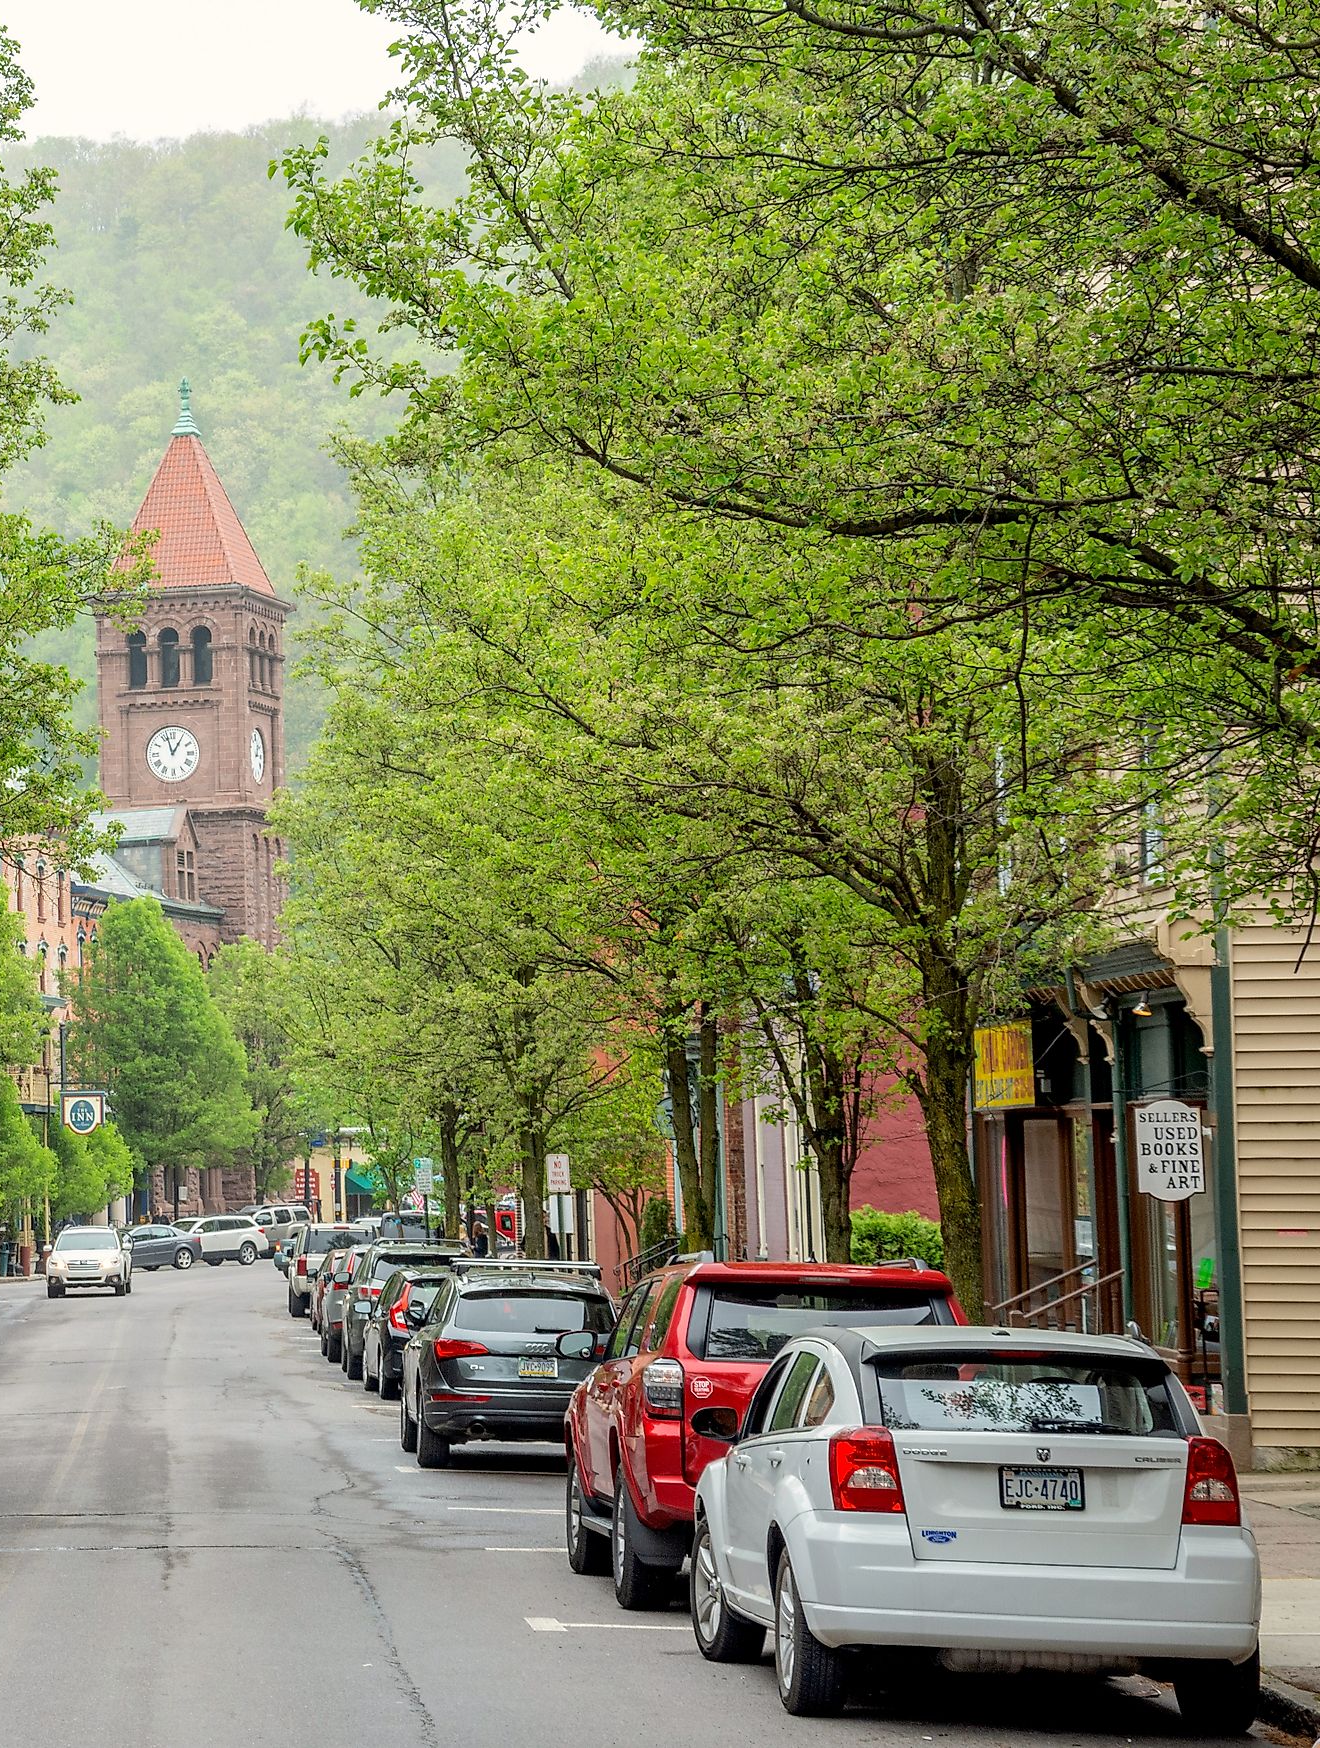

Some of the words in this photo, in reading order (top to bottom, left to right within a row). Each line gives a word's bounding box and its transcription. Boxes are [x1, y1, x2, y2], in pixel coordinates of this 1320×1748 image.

[72, 1112, 93, 1121] INN
[1139, 1112, 1198, 1122] SELLERS
[1154, 1127, 1198, 1140] USED
[1141, 1142, 1199, 1155] BOOKS
[553, 1160, 561, 1168] NO
[1148, 1163, 1158, 1173] &
[1161, 1160, 1200, 1173] FINE
[1166, 1176, 1200, 1188] ART
[902, 1447, 948, 1456] DODGE
[922, 1530, 957, 1539] LEHIGHTON
